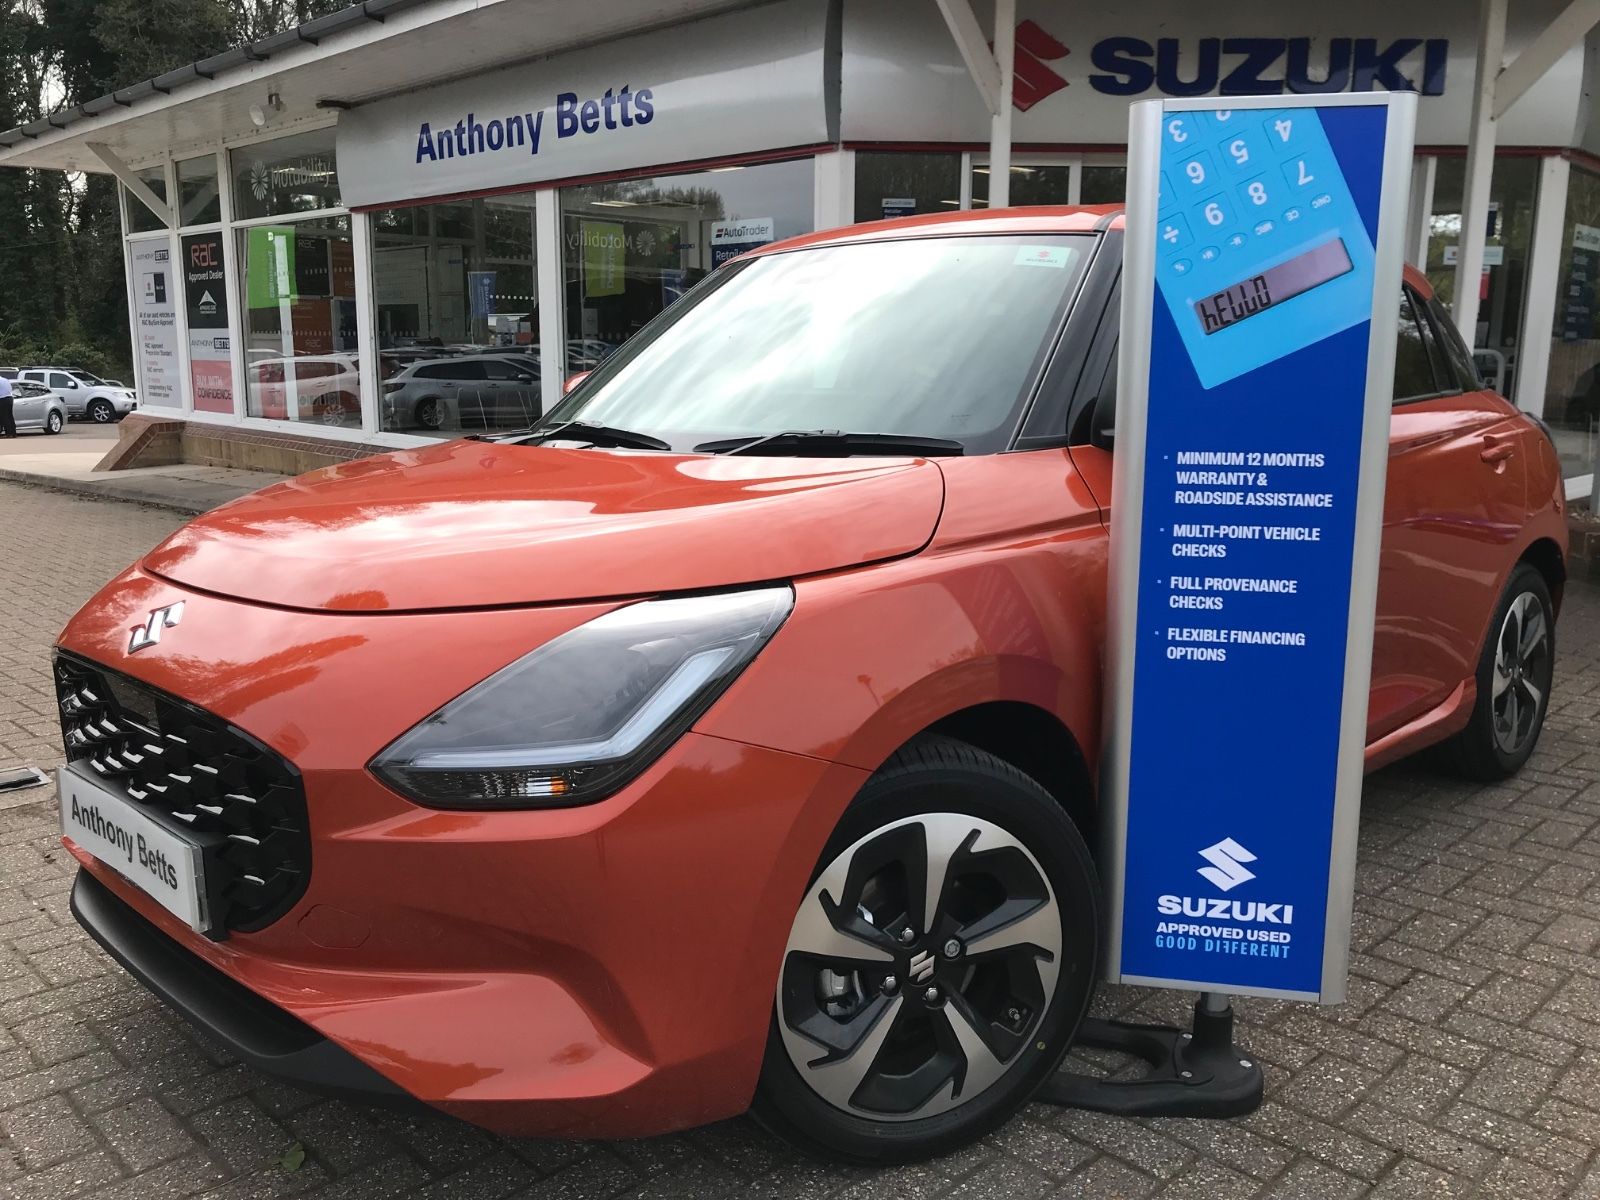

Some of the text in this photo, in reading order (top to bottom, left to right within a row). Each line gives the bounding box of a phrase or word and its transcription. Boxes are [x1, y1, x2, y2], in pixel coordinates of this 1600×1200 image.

[1088, 36, 1449, 97] SUZUKI
[416, 84, 654, 164] Anthony Betts
[1168, 120, 1187, 142] 3
[1274, 119, 1293, 143] 4
[1230, 140, 1249, 165] 5
[271, 157, 331, 190] Motability
[1298, 161, 1314, 185] 7
[1248, 181, 1267, 206] 8
[723, 225, 769, 238] AutoTrader
[188, 270, 224, 283] Approved Dealer
[1177, 452, 1325, 467] MINIMUM 12 MONTHS
[1176, 471, 1268, 486] WARRANTY &
[1175, 491, 1333, 507] ROADSIDE ASSISTANCE
[1173, 524, 1321, 541] MULTI-POINT VEHICLE
[1172, 544, 1227, 558] CHECKS
[1170, 576, 1298, 593] FULL PROVENANCE
[1169, 595, 1224, 610] CHECKS
[1167, 628, 1306, 646] FLEXIBLE FINANCING
[1166, 646, 1226, 661] OPTIONS
[71, 794, 178, 890] Anthony Betts
[1157, 895, 1293, 924] SUZUKI
[1156, 922, 1291, 943] APPROVED USED
[1155, 935, 1291, 958] GOOD DIFFERENT
